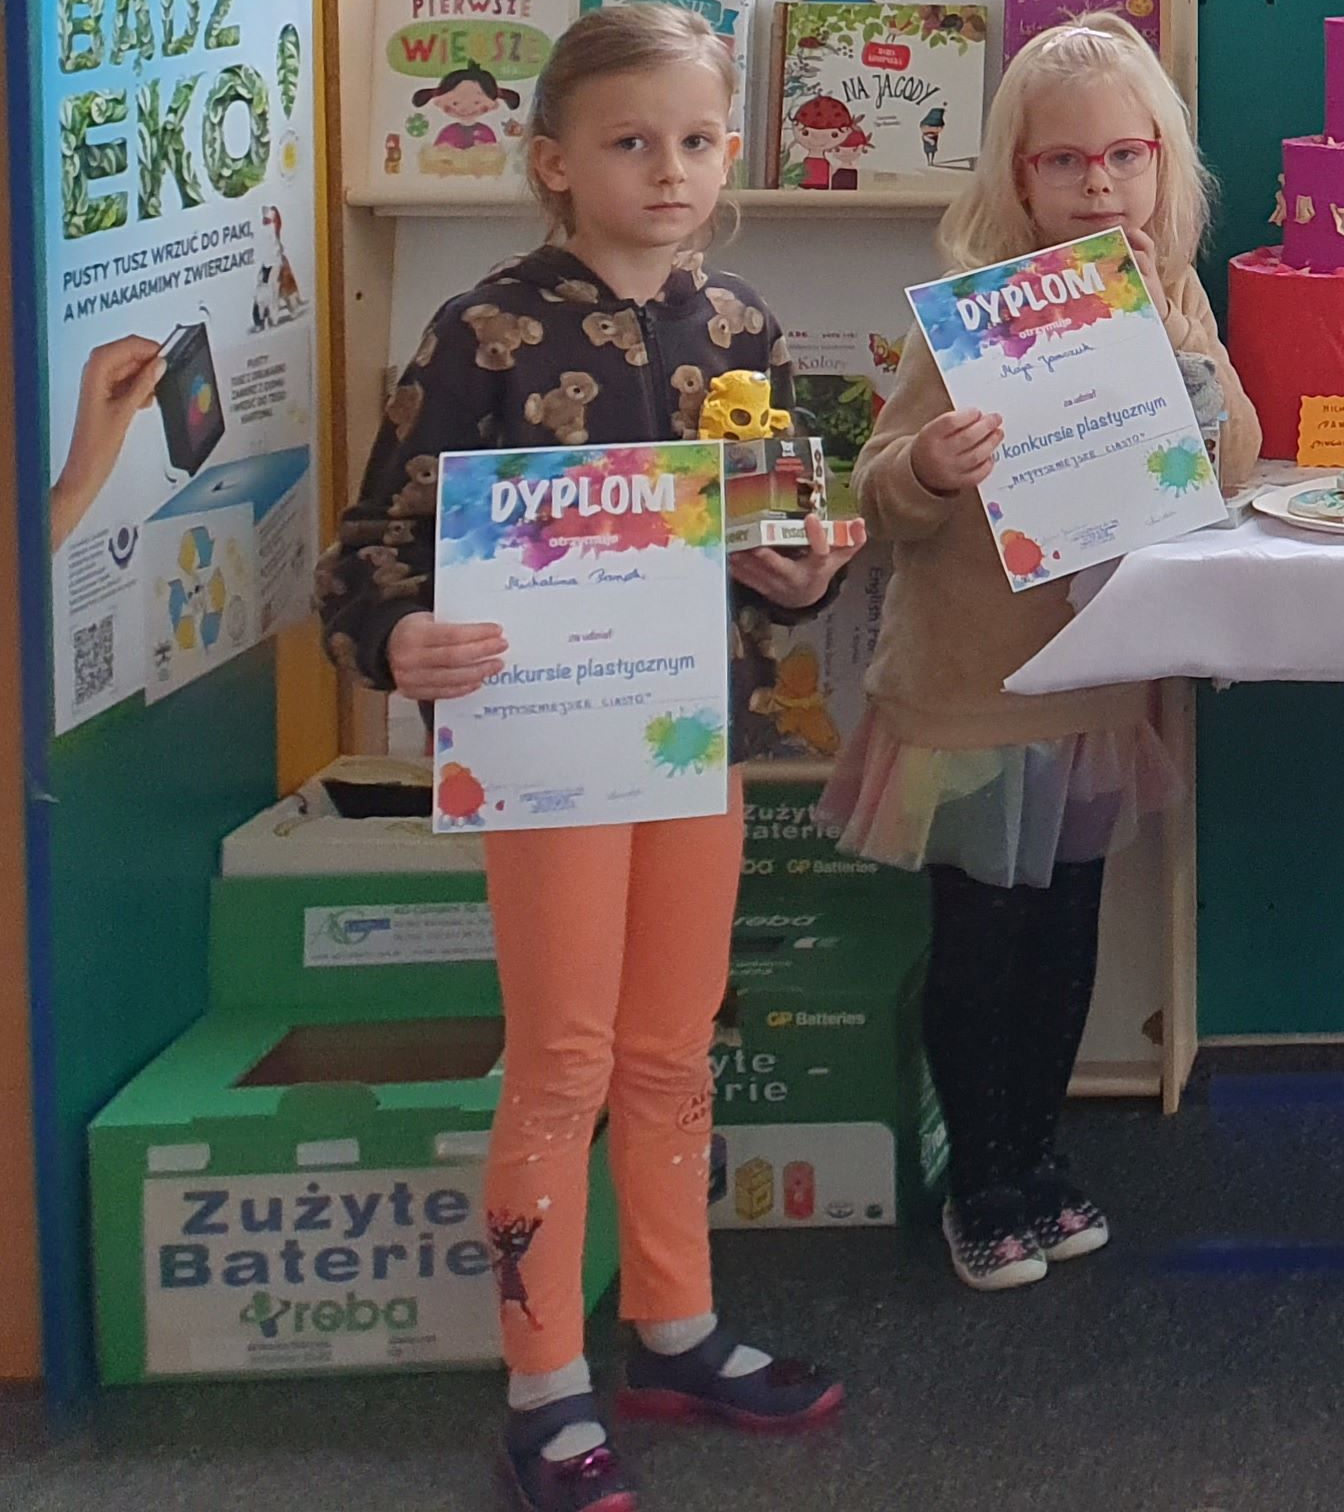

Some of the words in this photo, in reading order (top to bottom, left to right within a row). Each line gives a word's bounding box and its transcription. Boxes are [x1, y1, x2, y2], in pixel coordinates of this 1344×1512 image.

[842, 76, 870, 102] NA
[873, 74, 940, 109] JAGODY
[63, 262, 110, 292] PUSTY
[113, 250, 148, 276] TUSZ
[151, 229, 199, 265] WRZUĆ
[201, 230, 219, 250] DO
[64, 303, 73, 322] A
[78, 296, 97, 318] MY
[100, 271, 180, 311] NAKARMIMY
[956, 262, 1106, 332] DYPLOM
[1002, 426, 1073, 461] konkursie
[1076, 395, 1167, 441] plastycznym
[490, 473, 675, 523] DYPLOM
[576, 653, 695, 686] plastycznym
[743, 804, 821, 823] Zużyt
[743, 824, 841, 839] aterie
[796, 1012, 866, 1025] Batteries
[712, 1077, 788, 1102] rie
[182, 1181, 470, 1239] Zużyte
[159, 1233, 491, 1288] Baterie
